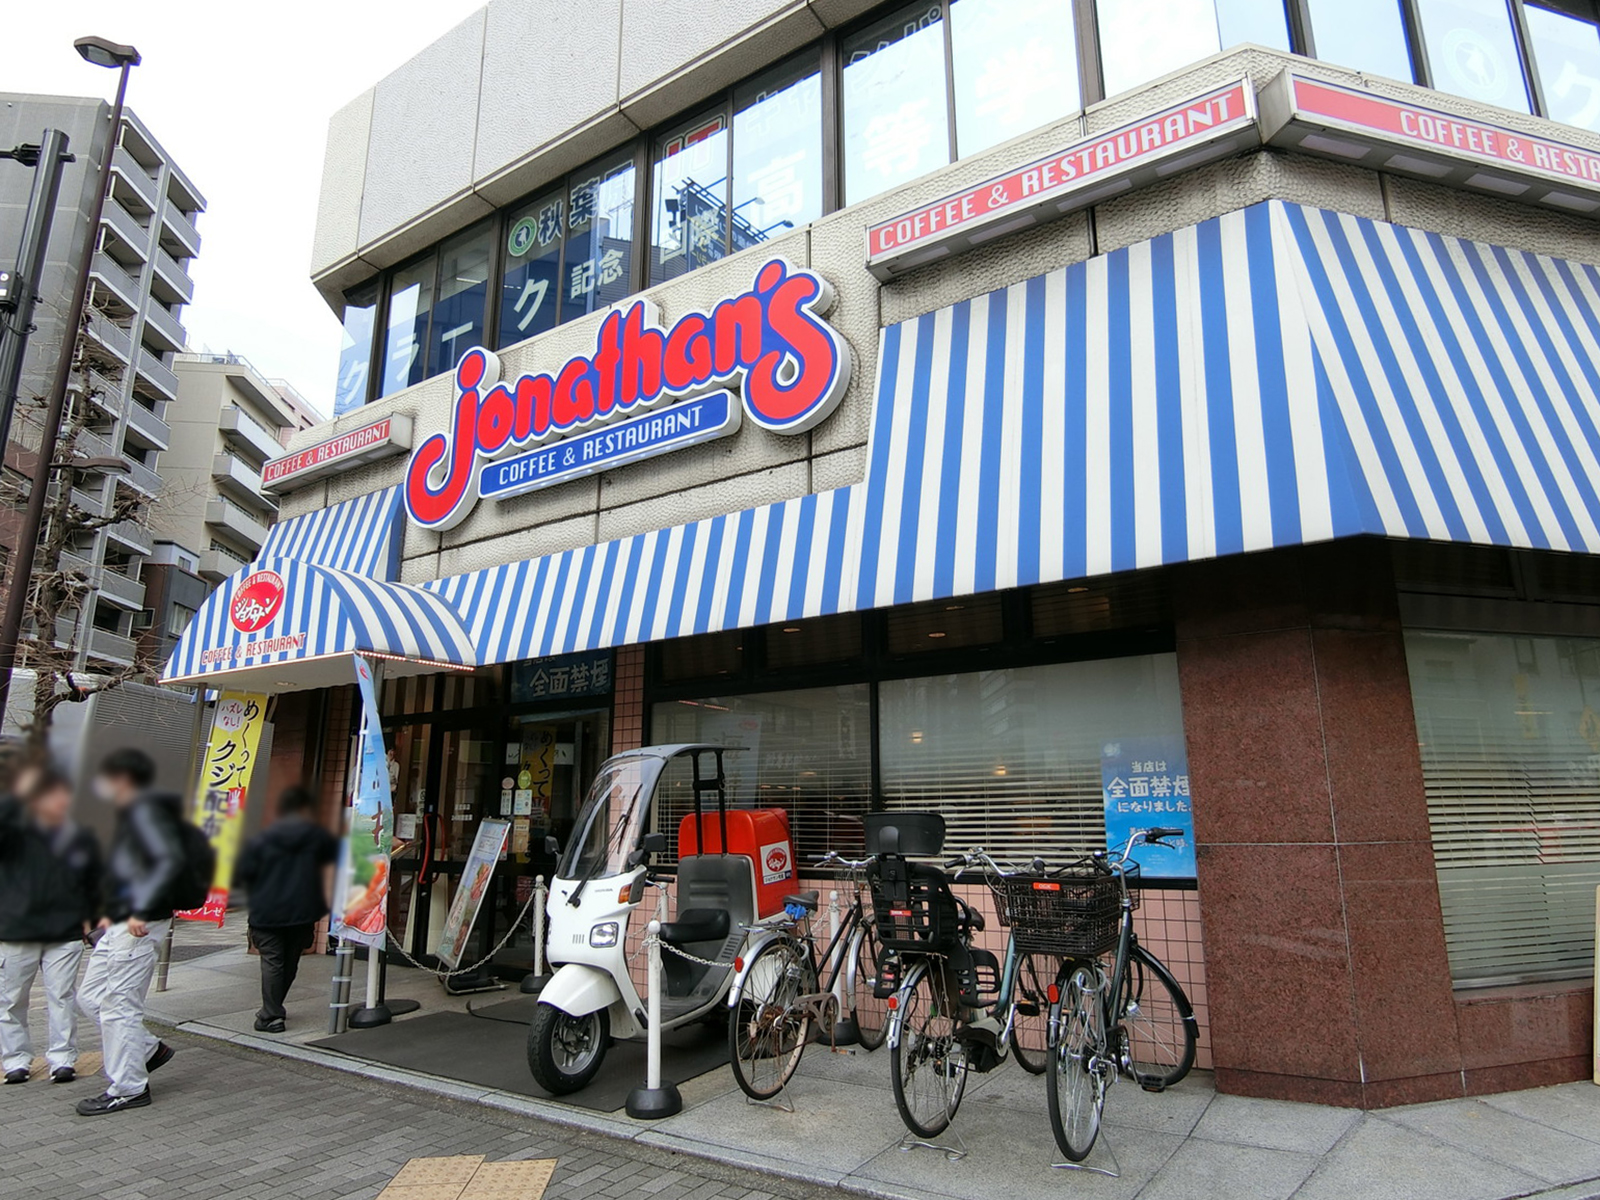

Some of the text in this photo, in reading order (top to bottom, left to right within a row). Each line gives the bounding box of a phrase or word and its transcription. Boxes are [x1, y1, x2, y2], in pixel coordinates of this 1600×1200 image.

[1400, 110, 1498, 156] COFFEE
[1506, 138, 1526, 162] &
[879, 93, 1233, 252] COFFEE & RESTAURANT
[267, 422, 388, 480] COFFEE & RESTAURANT
[499, 406, 703, 486] COFFEE & RESTAURANT
[235, 597, 279, 630] ジョナサン
[202, 633, 305, 664] COFFEE & RESTAURANT
[529, 658, 610, 697] 全面禁煙
[221, 702, 243, 714] ハズレ
[1132, 761, 1167, 774] 当店は
[1107, 775, 1191, 798] 全面禁煙
